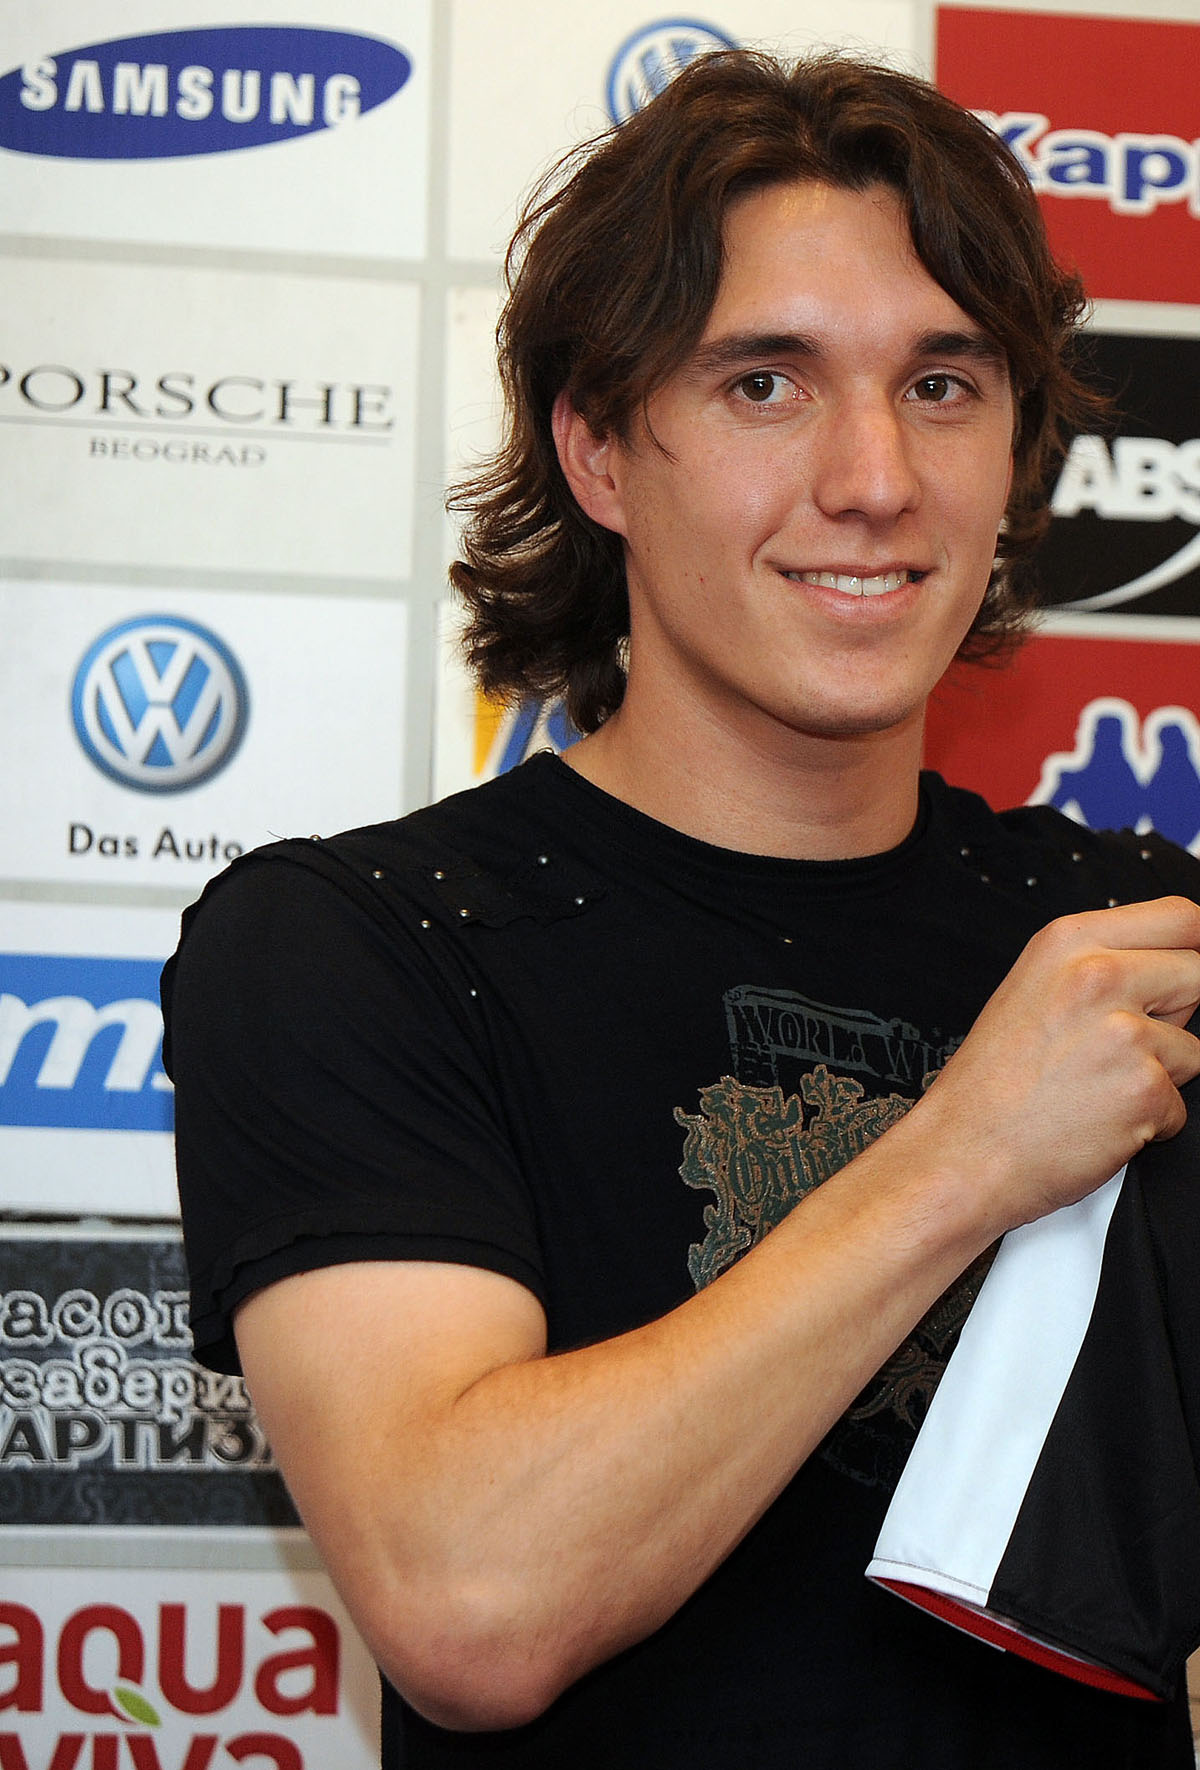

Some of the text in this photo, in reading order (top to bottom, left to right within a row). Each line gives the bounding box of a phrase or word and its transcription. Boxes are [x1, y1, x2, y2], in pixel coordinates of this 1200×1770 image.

[20, 57, 363, 127] SAMSUNG
[89, 437, 267, 468] BEOGRAD
[68, 822, 244, 861] Das Auto
[0, 1411, 274, 1466] АРТИЗ
